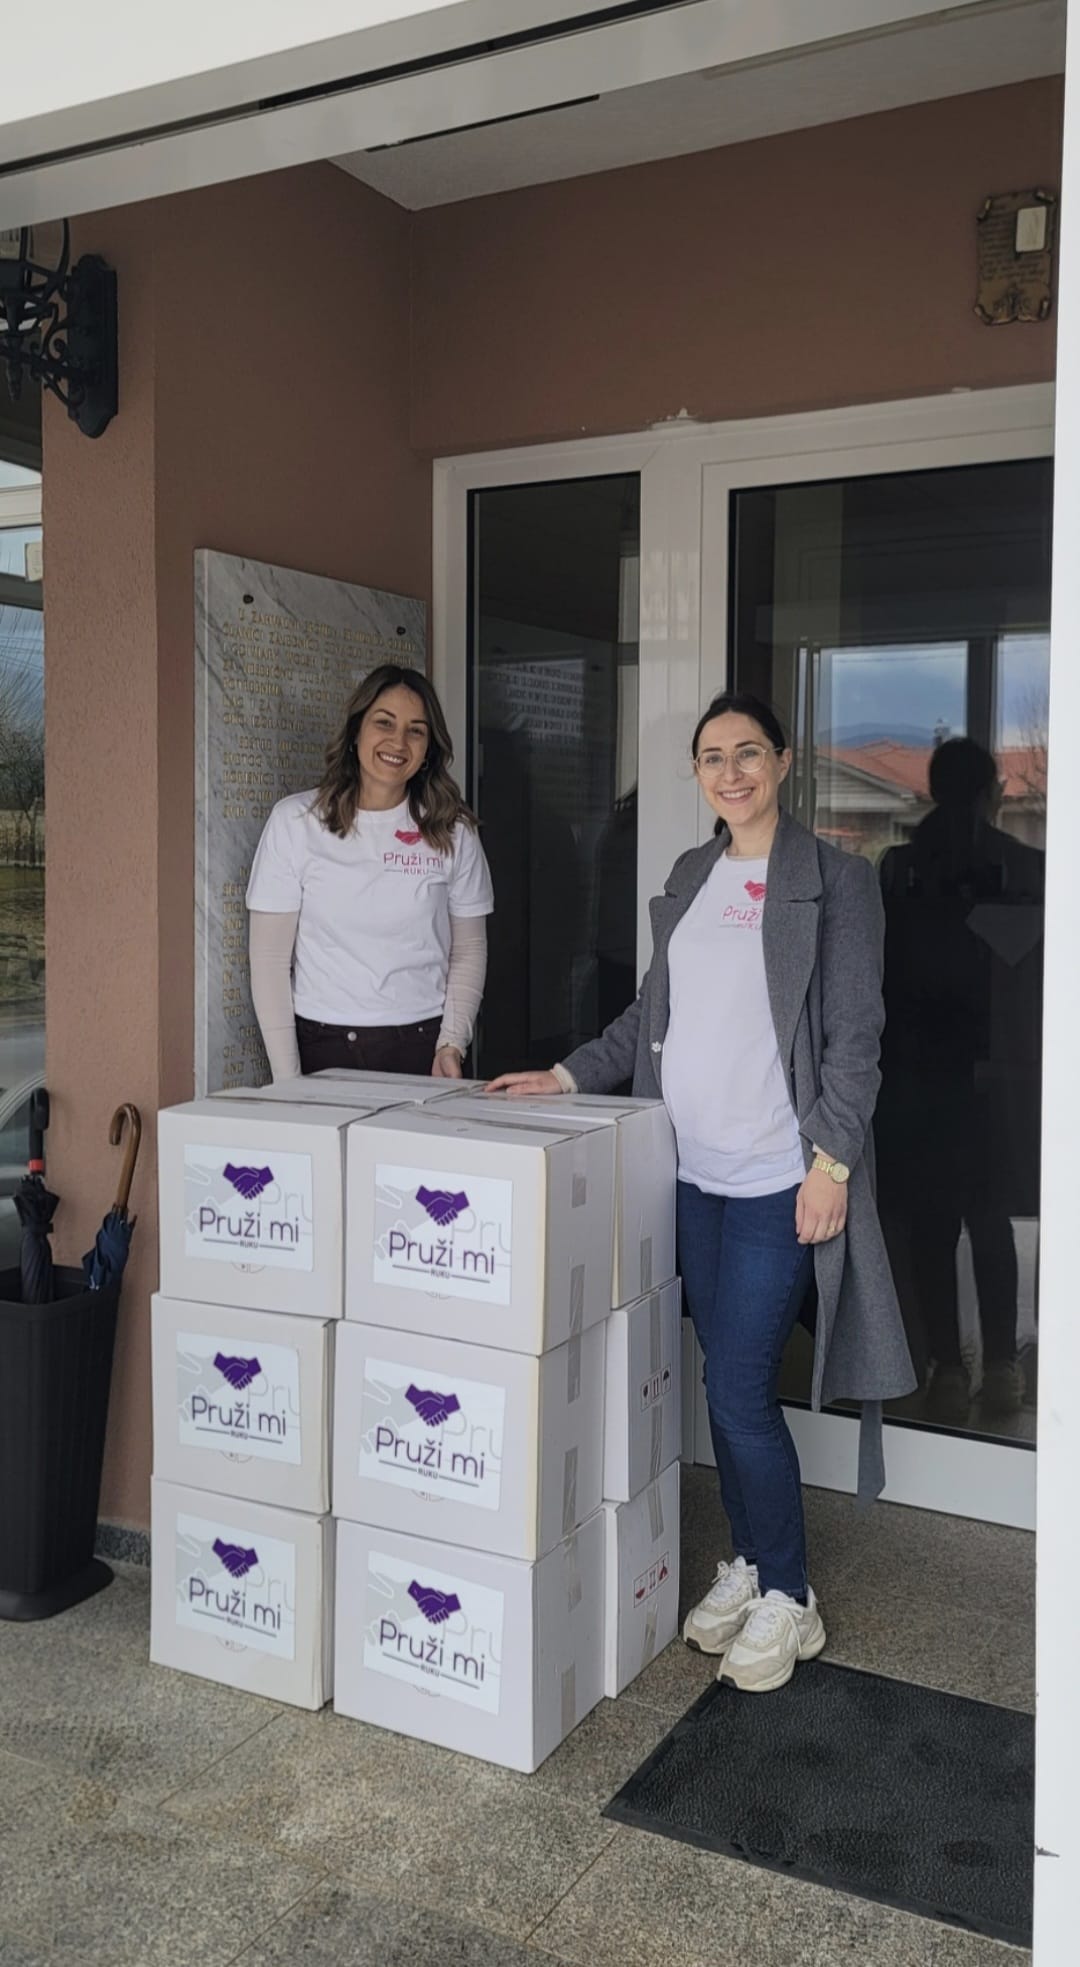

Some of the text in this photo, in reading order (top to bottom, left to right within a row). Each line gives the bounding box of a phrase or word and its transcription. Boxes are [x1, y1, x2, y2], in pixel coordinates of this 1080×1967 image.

[383, 851, 444, 869] Pruži mi
[722, 904, 762, 921] Pruži
[199, 1206, 299, 1243] Pruži mi
[239, 1240, 259, 1248] RUKU
[389, 1230, 495, 1275] Pruži mi
[430, 1268, 451, 1279] RUKU
[191, 1395, 286, 1436] Pruži mi
[230, 1430, 249, 1440] RUKU
[375, 1426, 485, 1480] Pruži mi
[417, 1467, 438, 1479] RUKU
[189, 1576, 281, 1630] Pruži mi
[226, 1616, 244, 1628] RUKU
[379, 1619, 485, 1682] Pruži mi
[420, 1663, 440, 1677] RUKU
